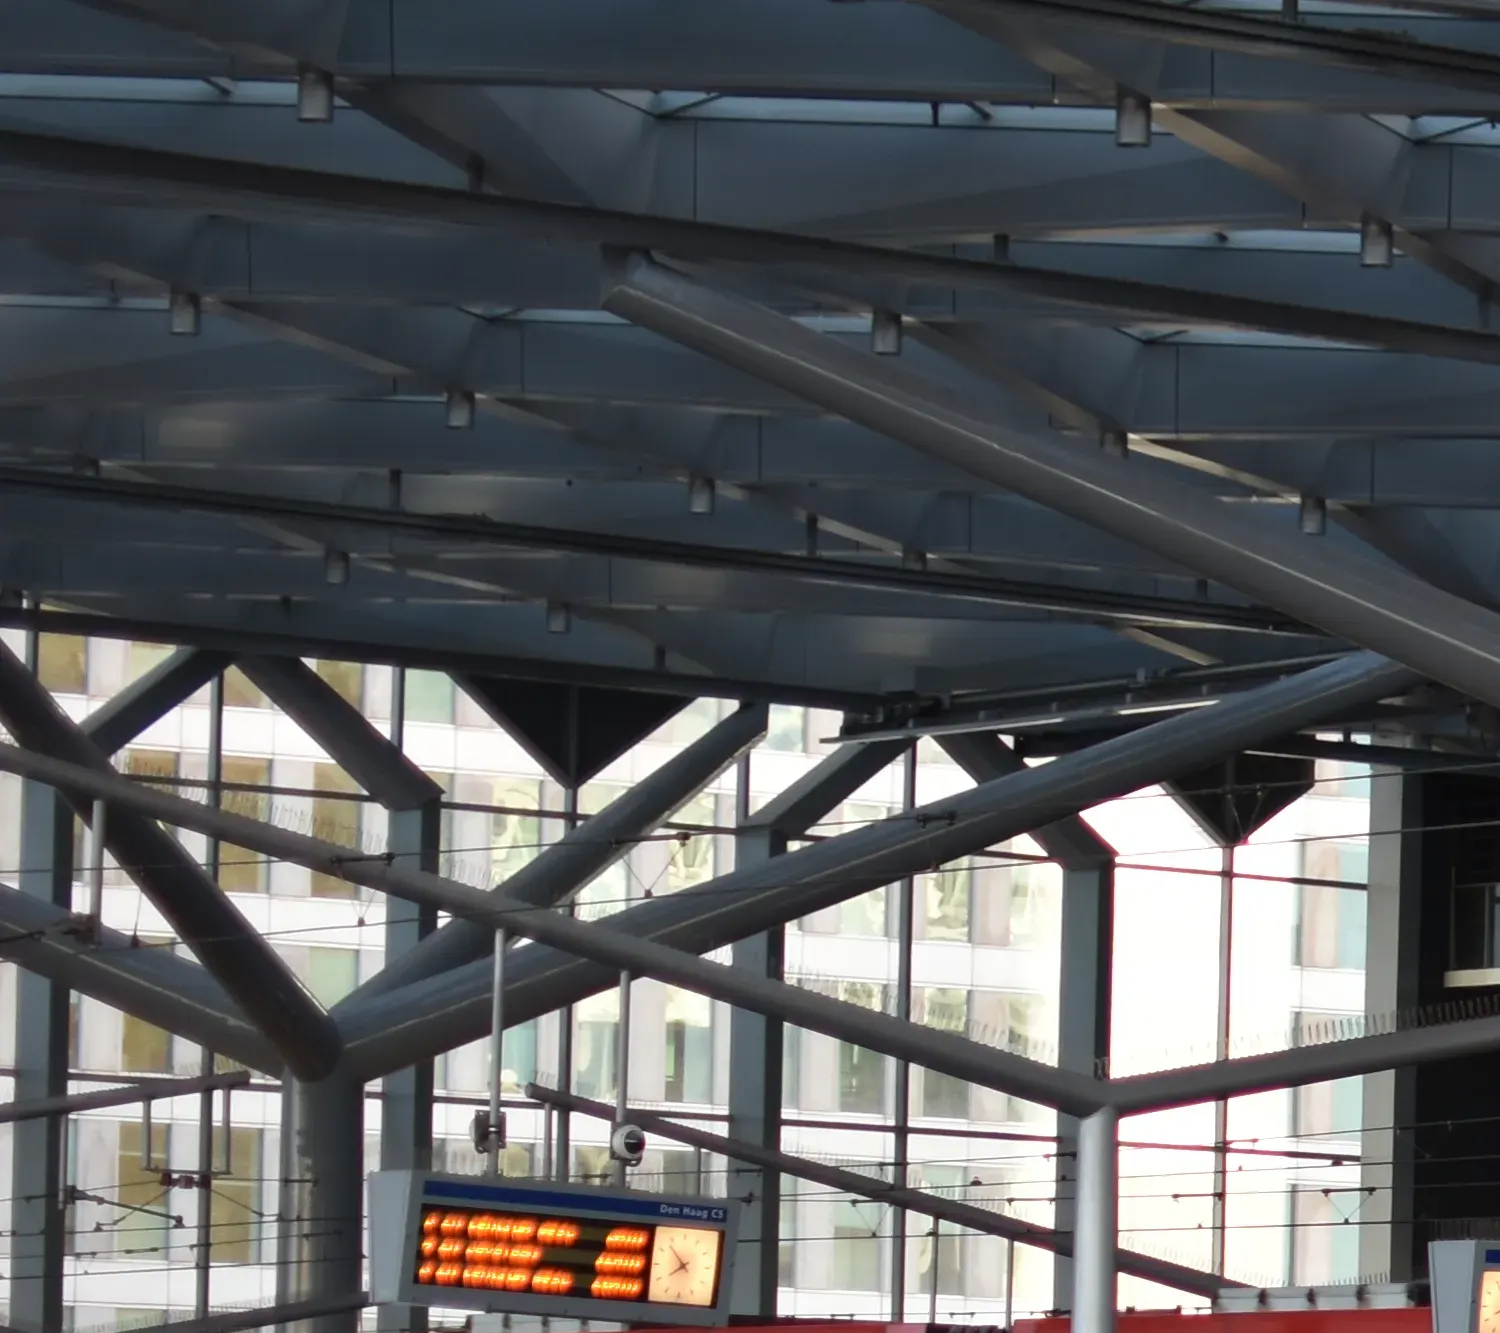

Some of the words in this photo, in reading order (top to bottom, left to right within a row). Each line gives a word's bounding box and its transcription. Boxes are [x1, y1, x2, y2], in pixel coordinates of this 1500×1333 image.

[660, 1204, 680, 1215] Den
[683, 1206, 709, 1218] Haag
[711, 1208, 724, 1219] CS
